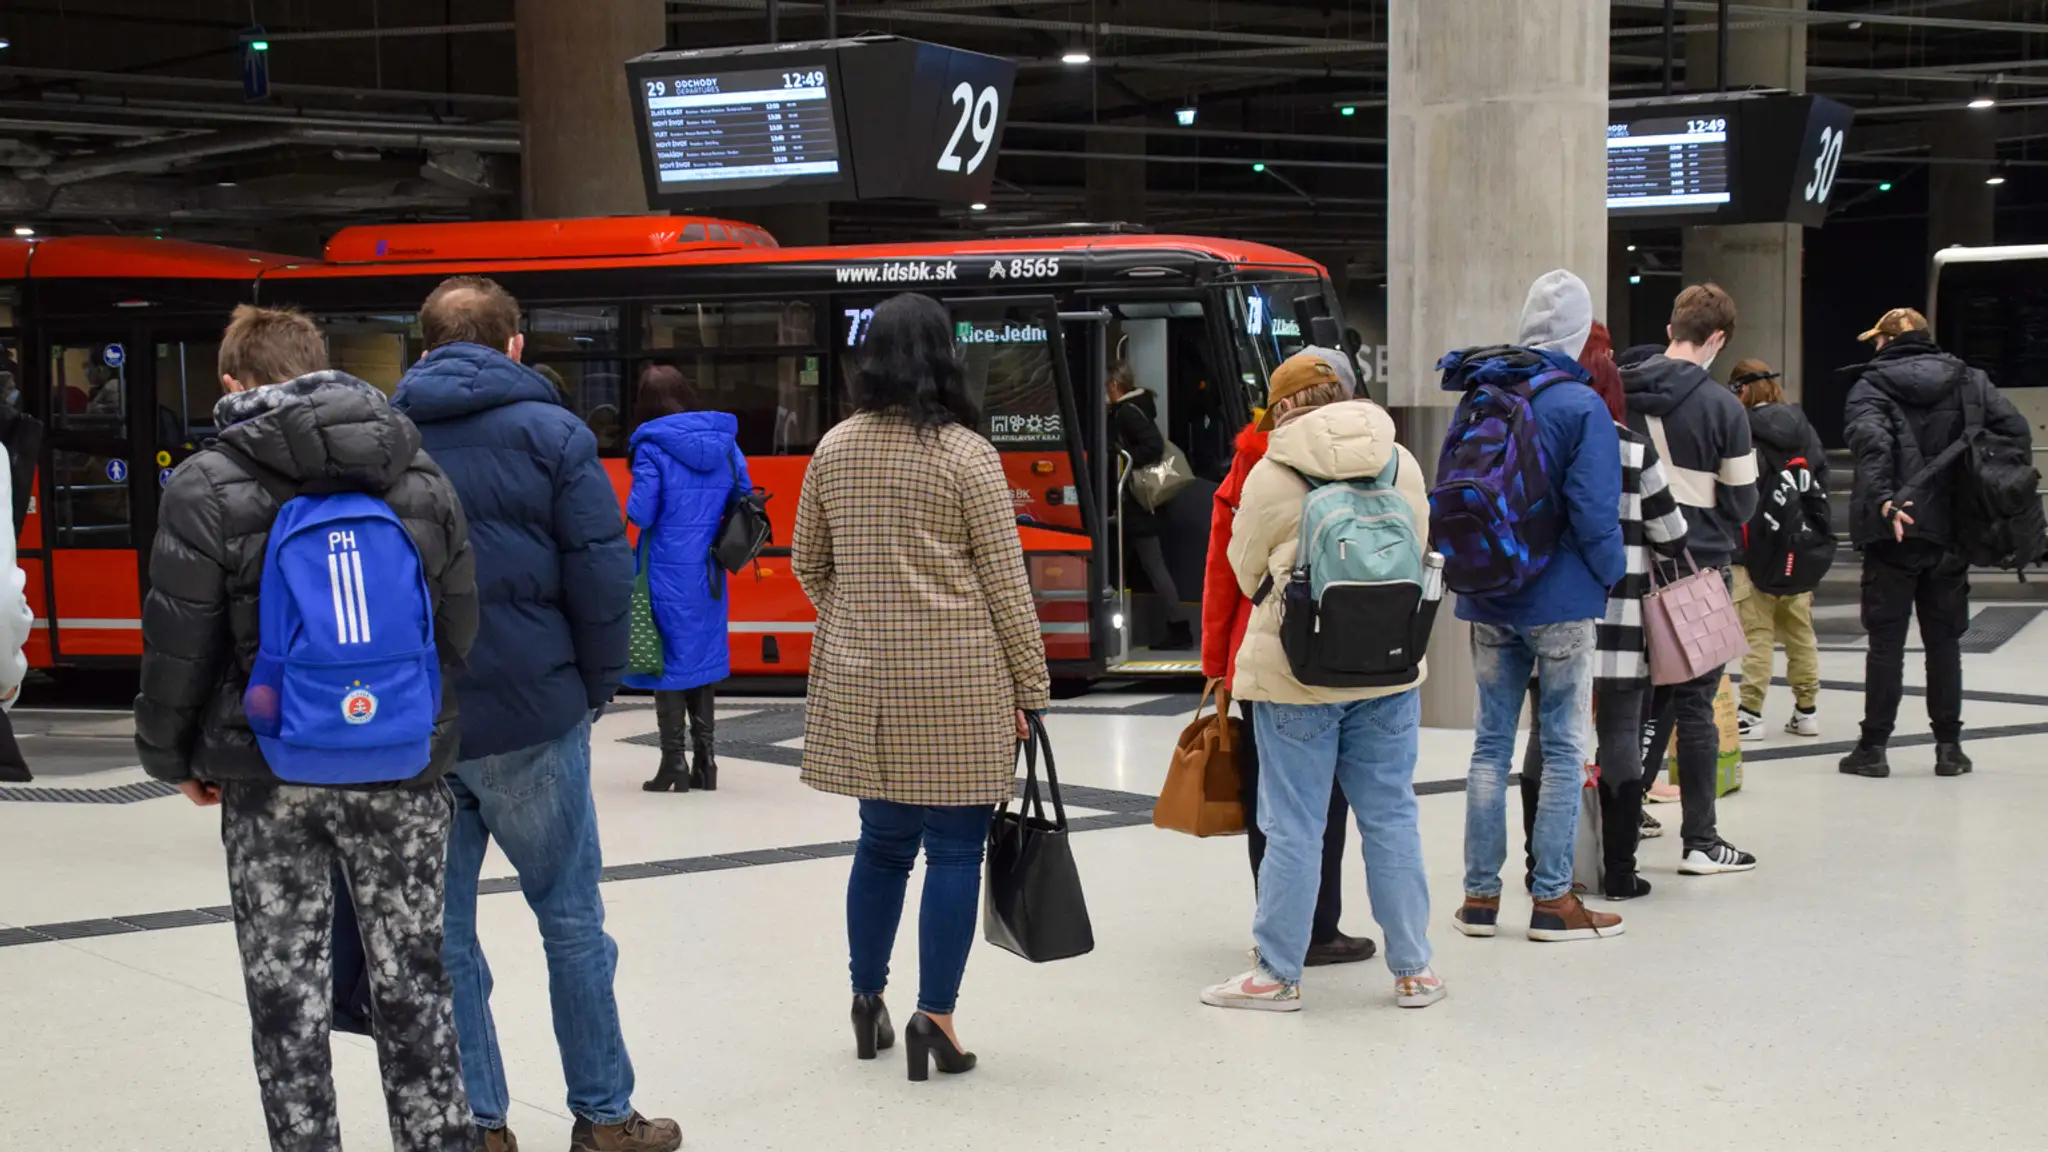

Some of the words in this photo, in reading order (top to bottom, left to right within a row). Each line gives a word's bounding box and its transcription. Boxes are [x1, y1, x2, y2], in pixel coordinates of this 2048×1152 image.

[647, 81, 666, 97] 29
[675, 78, 717, 89] ODCHODY
[782, 71, 825, 88] 12:49
[676, 86, 720, 96] DEPARTURES
[937, 81, 999, 176] 29
[1687, 118, 1726, 134] 12:49
[1805, 126, 1843, 204] 30
[836, 262, 957, 282] www.idsbk.sk
[1010, 257, 1059, 278] 8565
[328, 530, 356, 552] PH
